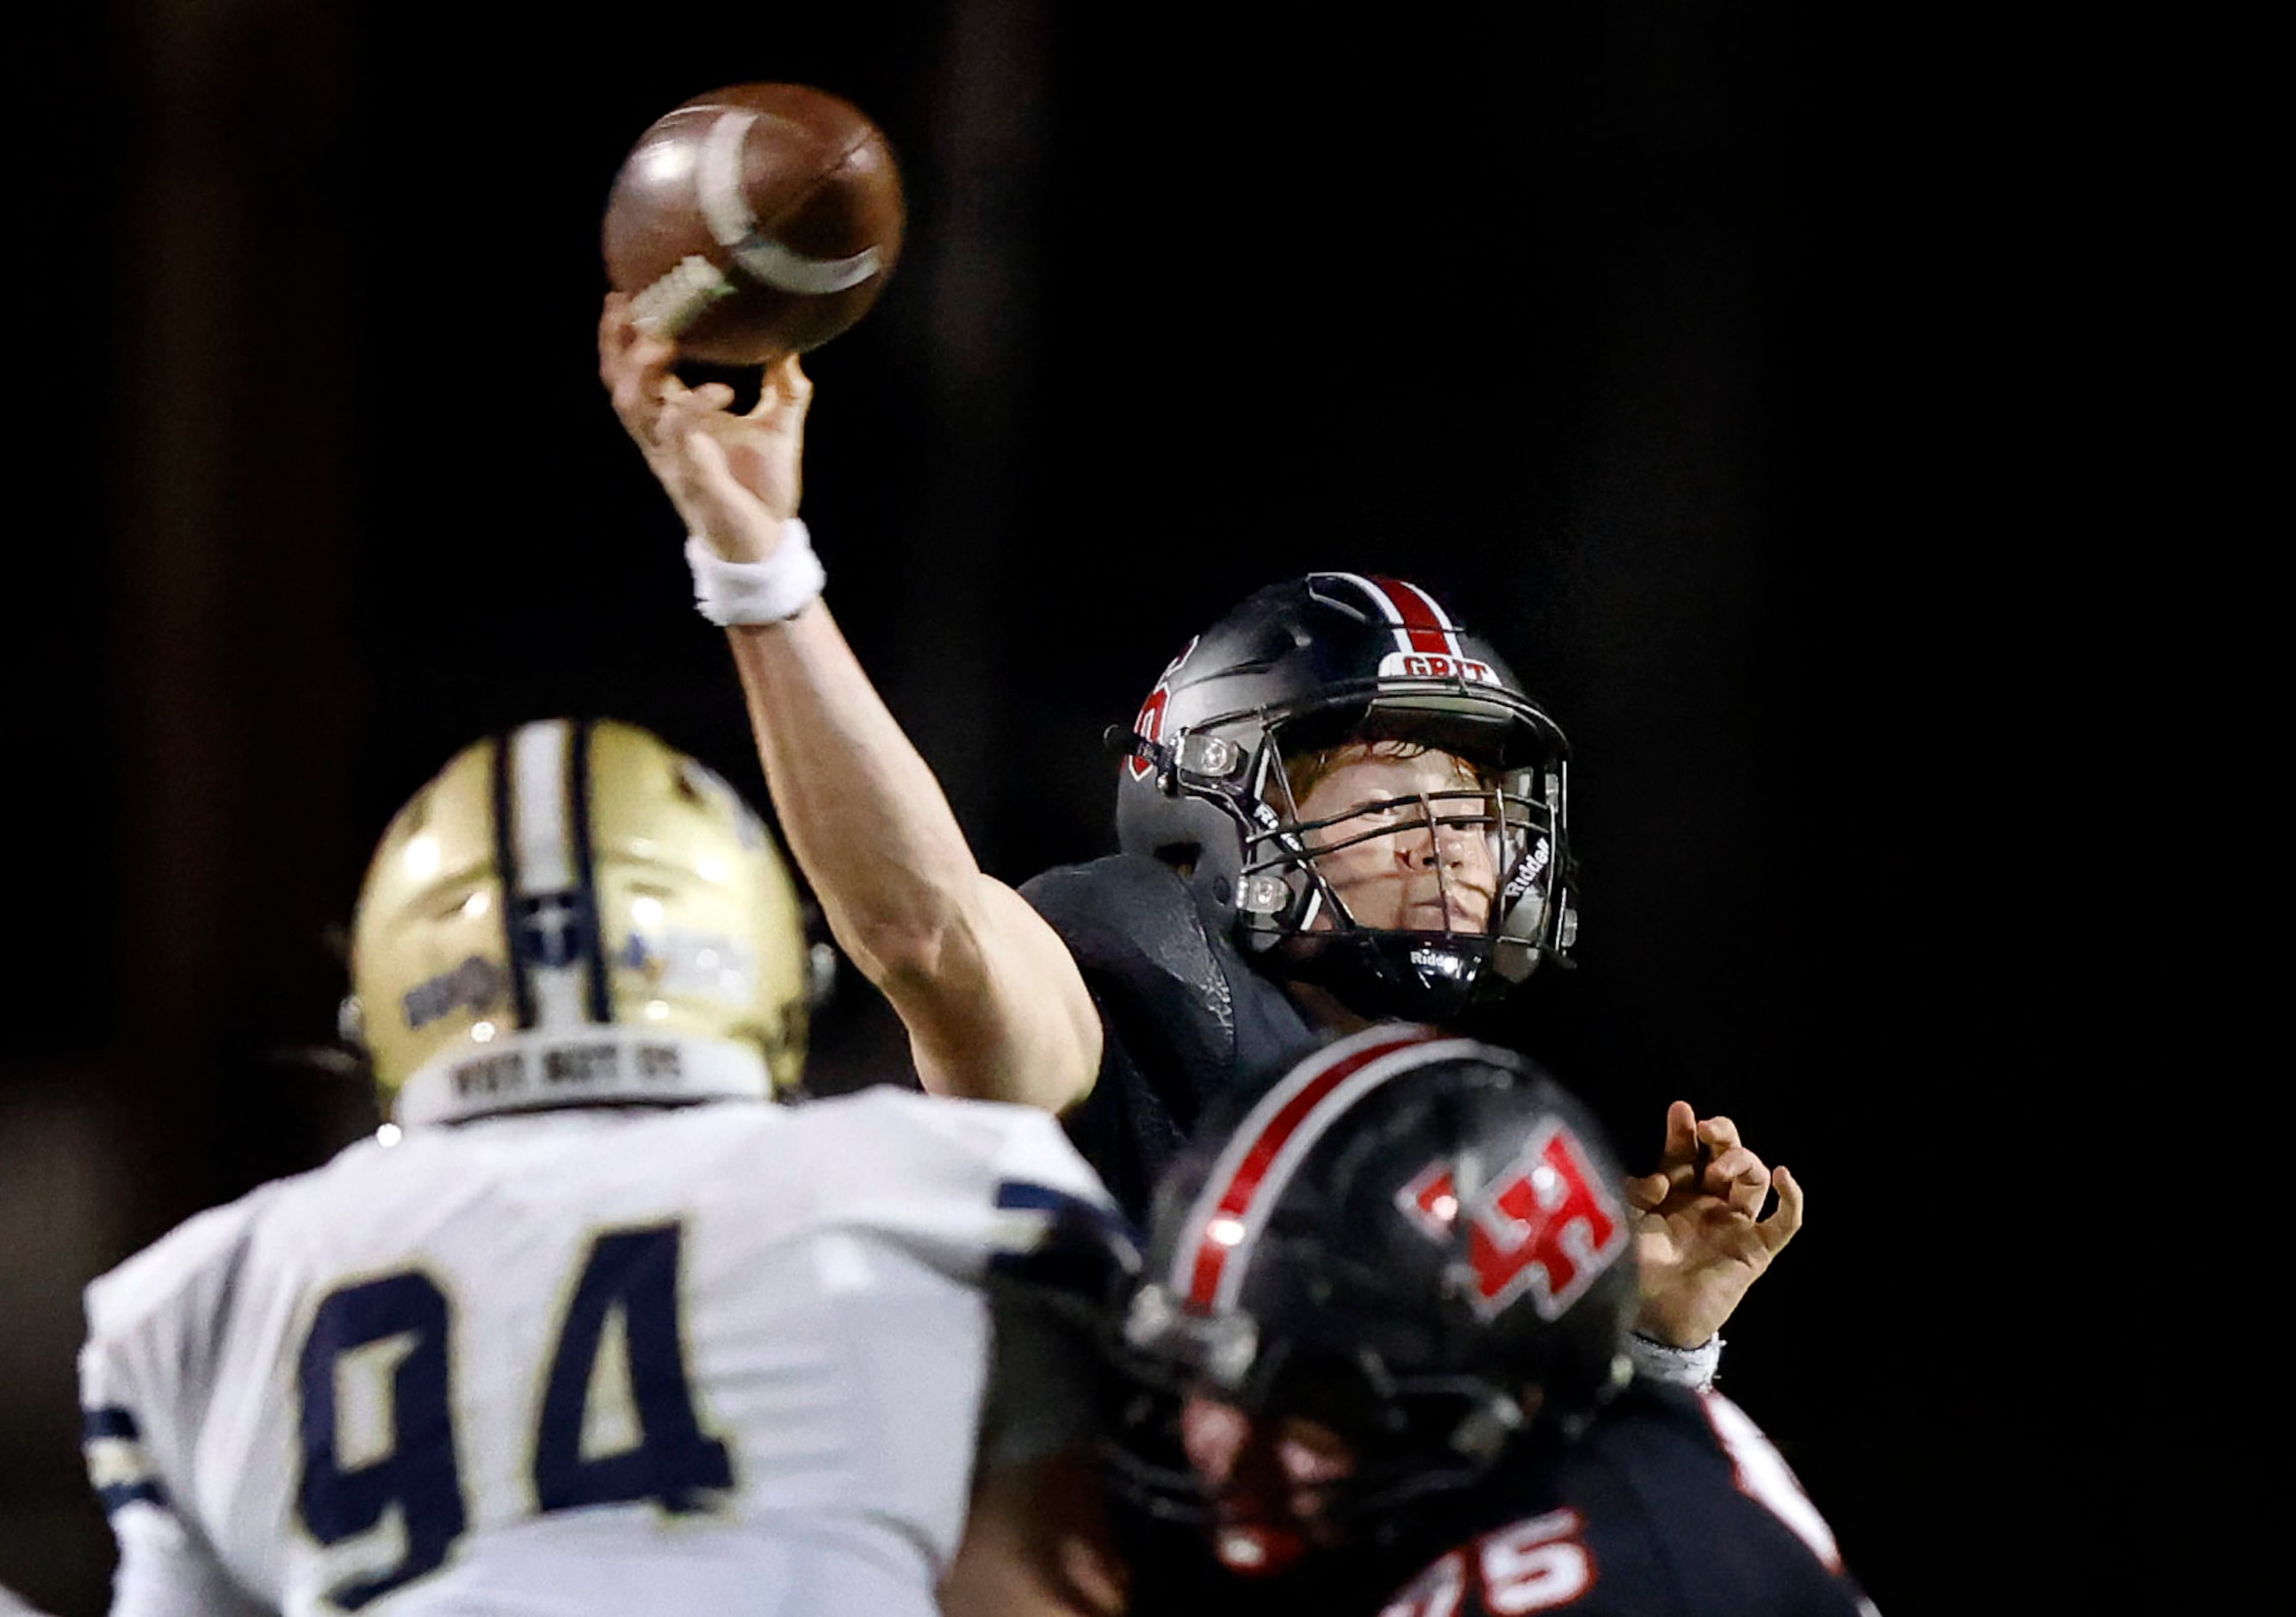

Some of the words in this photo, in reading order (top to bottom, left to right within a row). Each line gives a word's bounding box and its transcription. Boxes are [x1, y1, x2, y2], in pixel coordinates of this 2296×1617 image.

[1403, 656, 1487, 682] GRIT
[1504, 837, 1549, 896] Riddell
[1409, 949, 1459, 972] Ridd
[295, 1214, 737, 1614] 94
